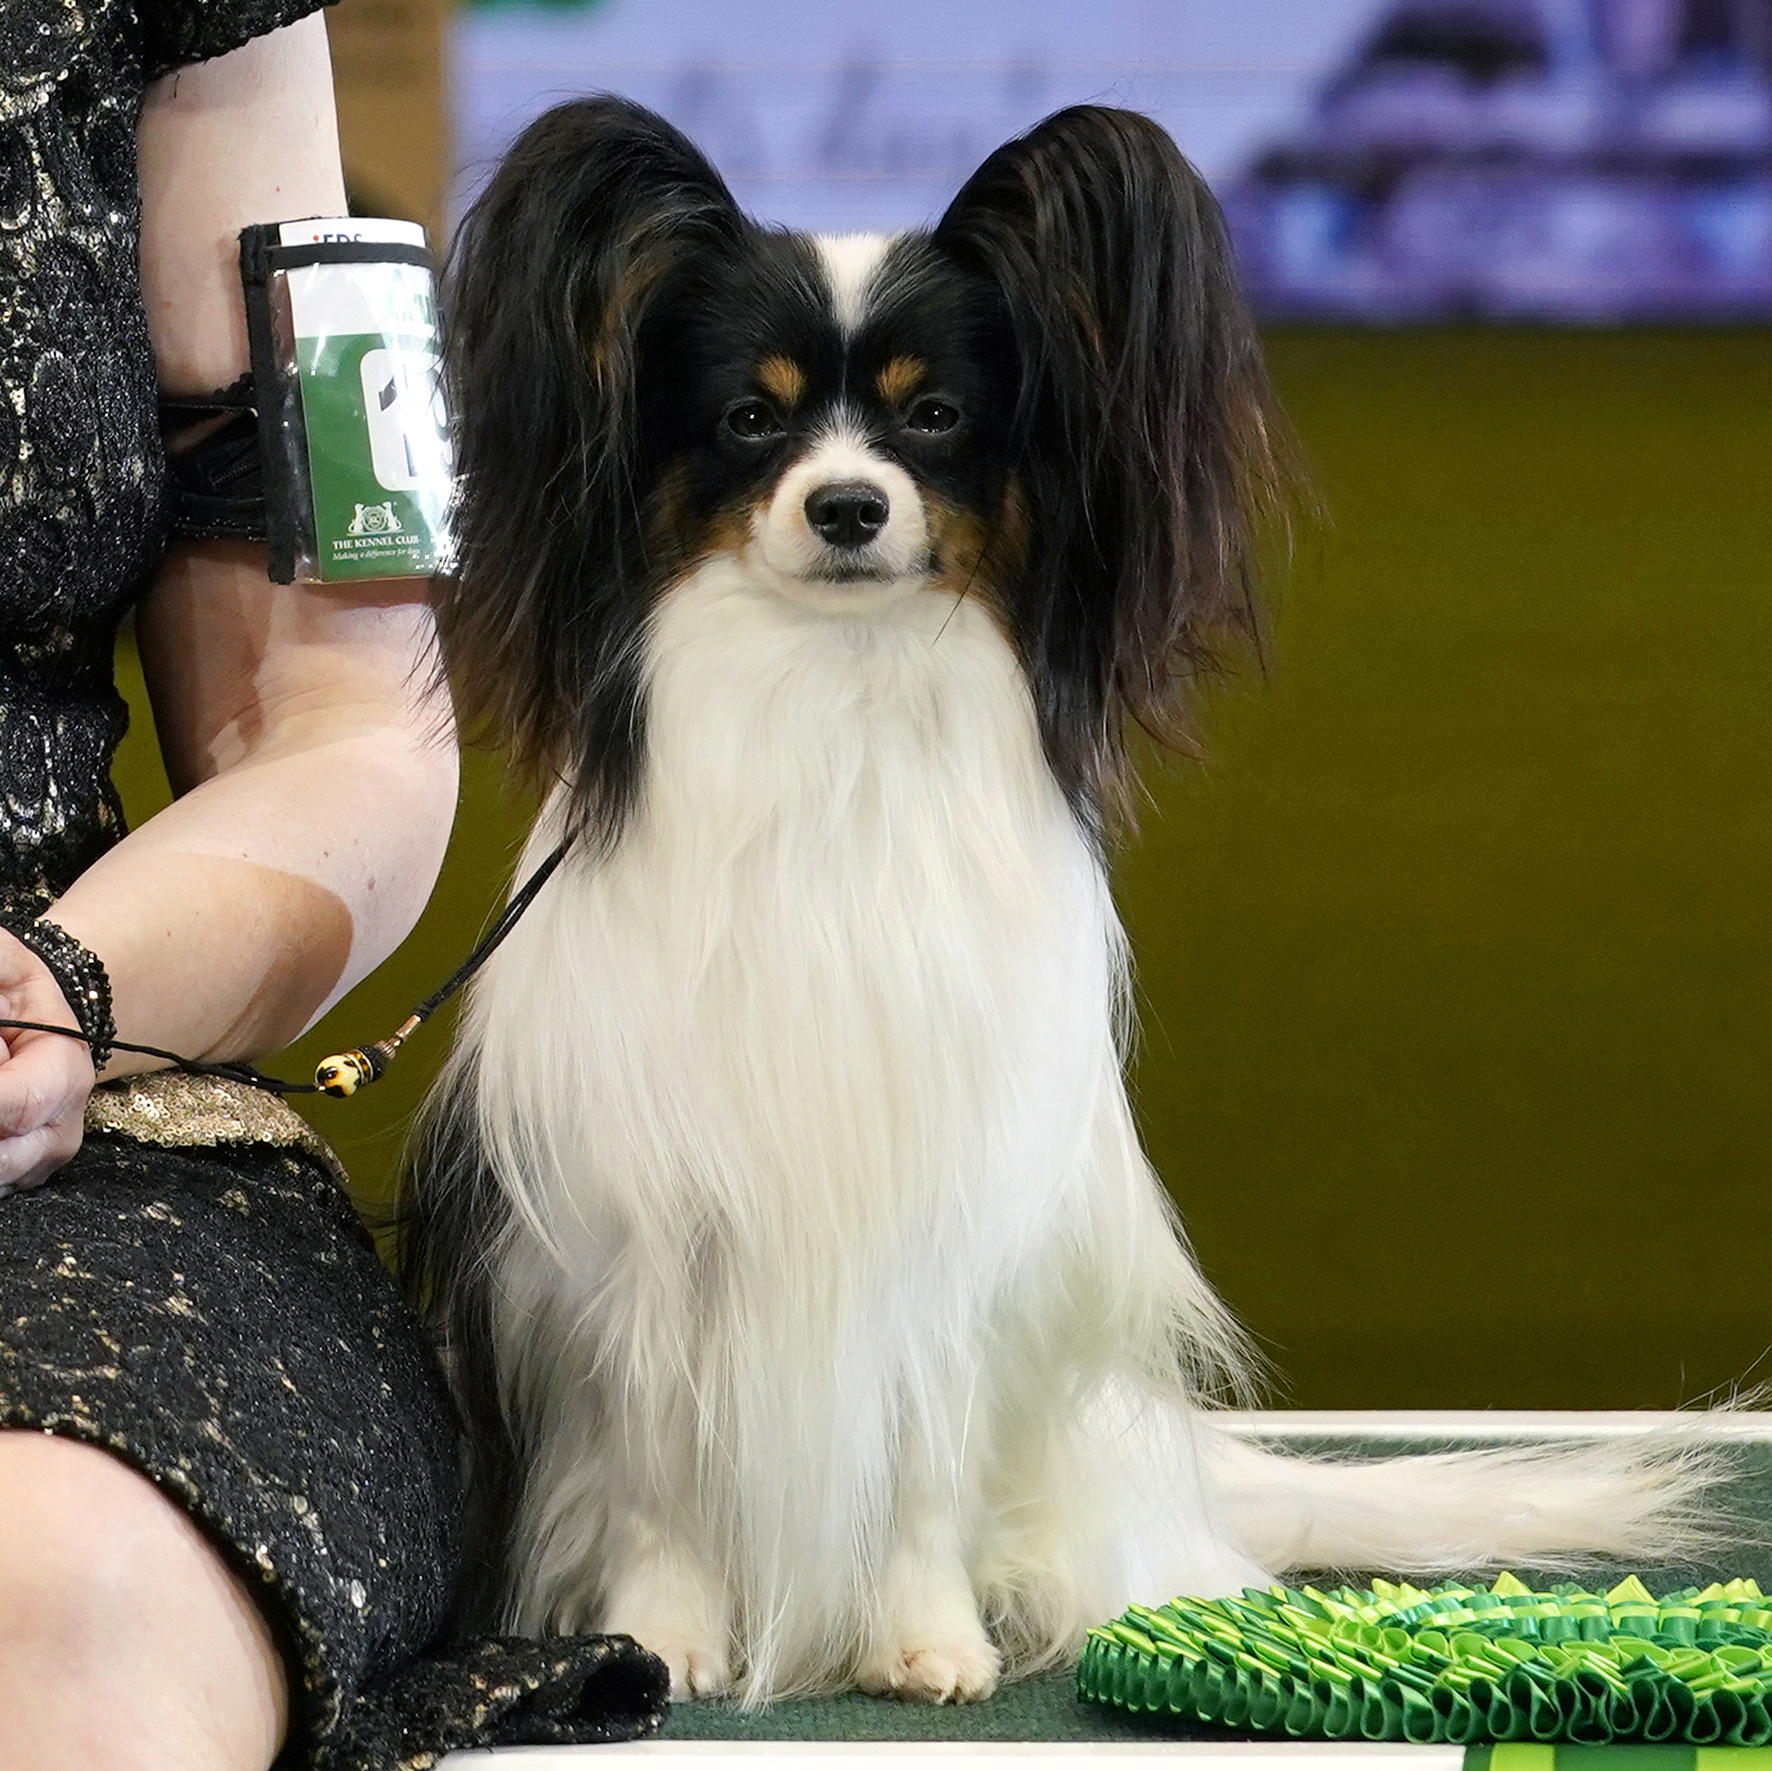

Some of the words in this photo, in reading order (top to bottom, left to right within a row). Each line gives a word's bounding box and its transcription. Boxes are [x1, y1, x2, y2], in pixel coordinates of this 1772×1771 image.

[332, 540, 353, 549] THE
[355, 537, 394, 548] KENNEL
[395, 535, 419, 544] CLUB
